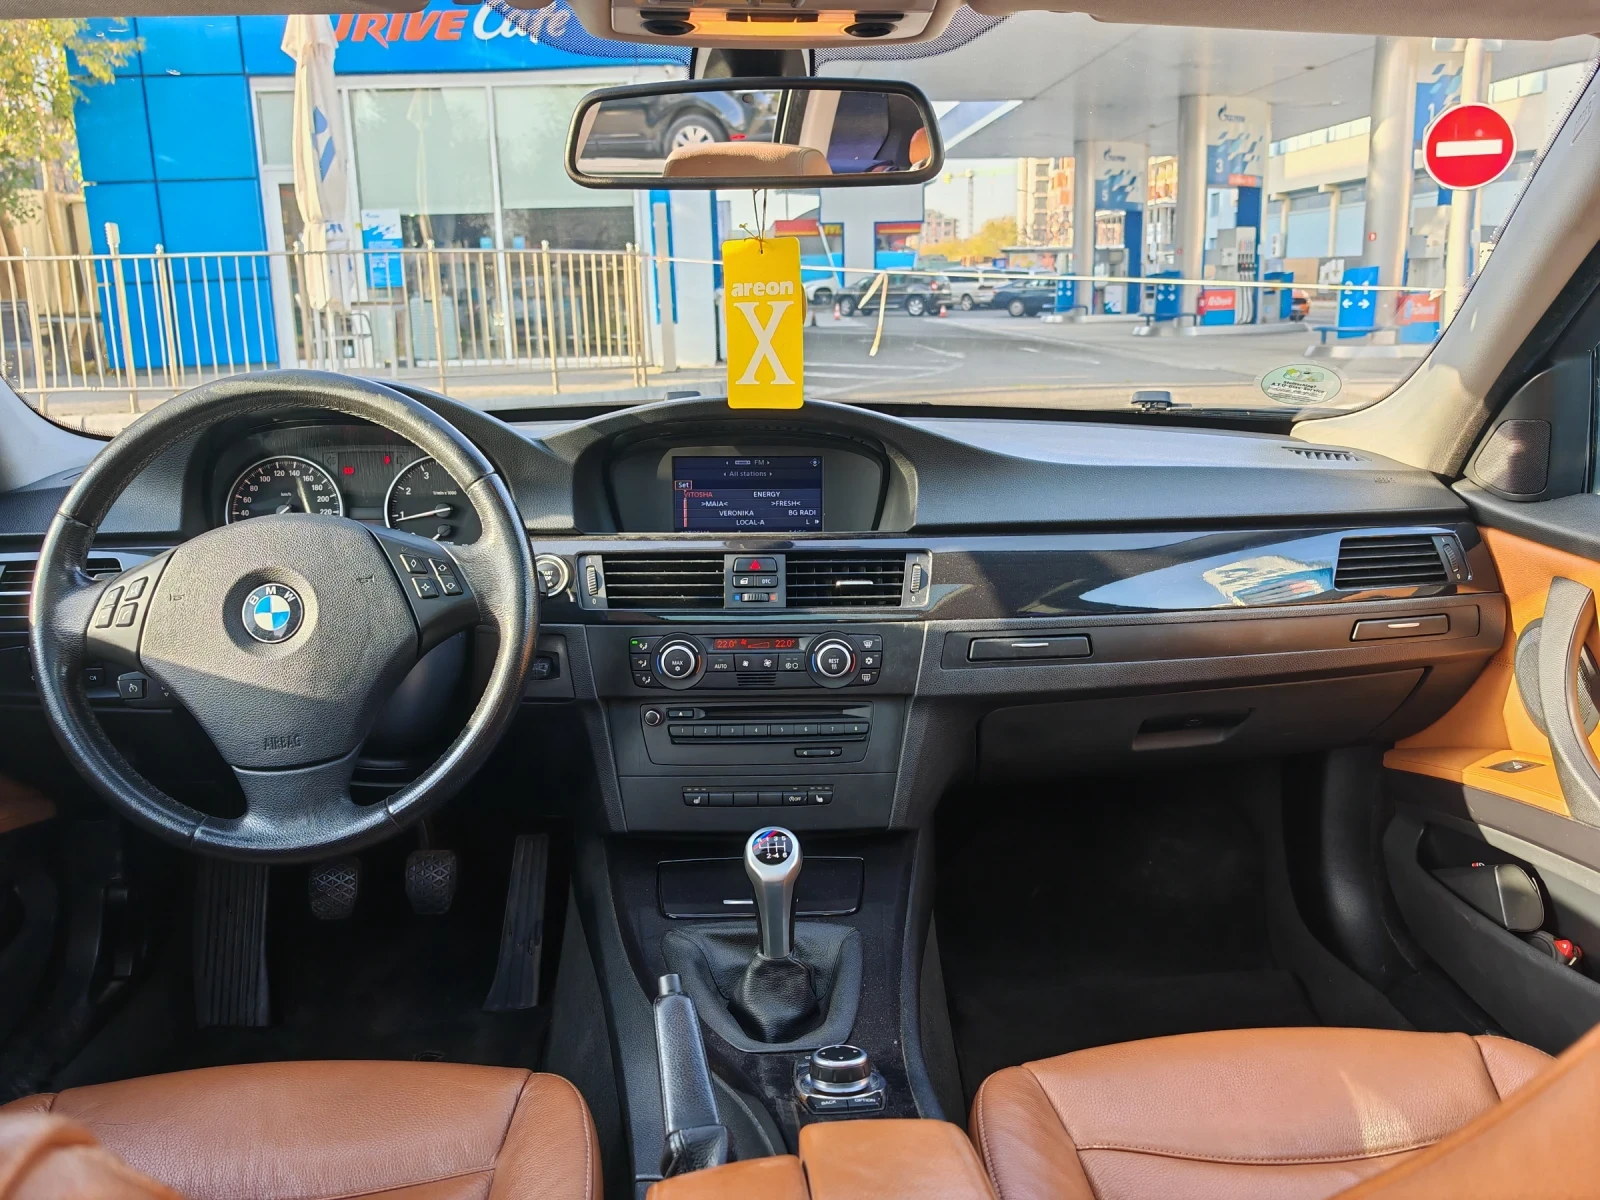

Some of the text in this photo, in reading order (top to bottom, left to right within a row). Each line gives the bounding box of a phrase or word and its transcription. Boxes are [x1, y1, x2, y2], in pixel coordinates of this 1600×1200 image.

[1215, 158, 1224, 174] 3
[731, 281, 794, 297] areon
[733, 301, 796, 385] X
[273, 469, 286, 478] 120
[288, 469, 301, 477] 140
[423, 472, 430, 480] 3
[259, 474, 271, 483] 100
[302, 474, 314, 482] 160
[678, 481, 690, 489] Set
[405, 488, 412, 496] 2
[243, 496, 252, 504] 60
[319, 508, 333, 516] 220
[248, 585, 296, 606] BMW
[262, 734, 302, 751] AIRBAG
